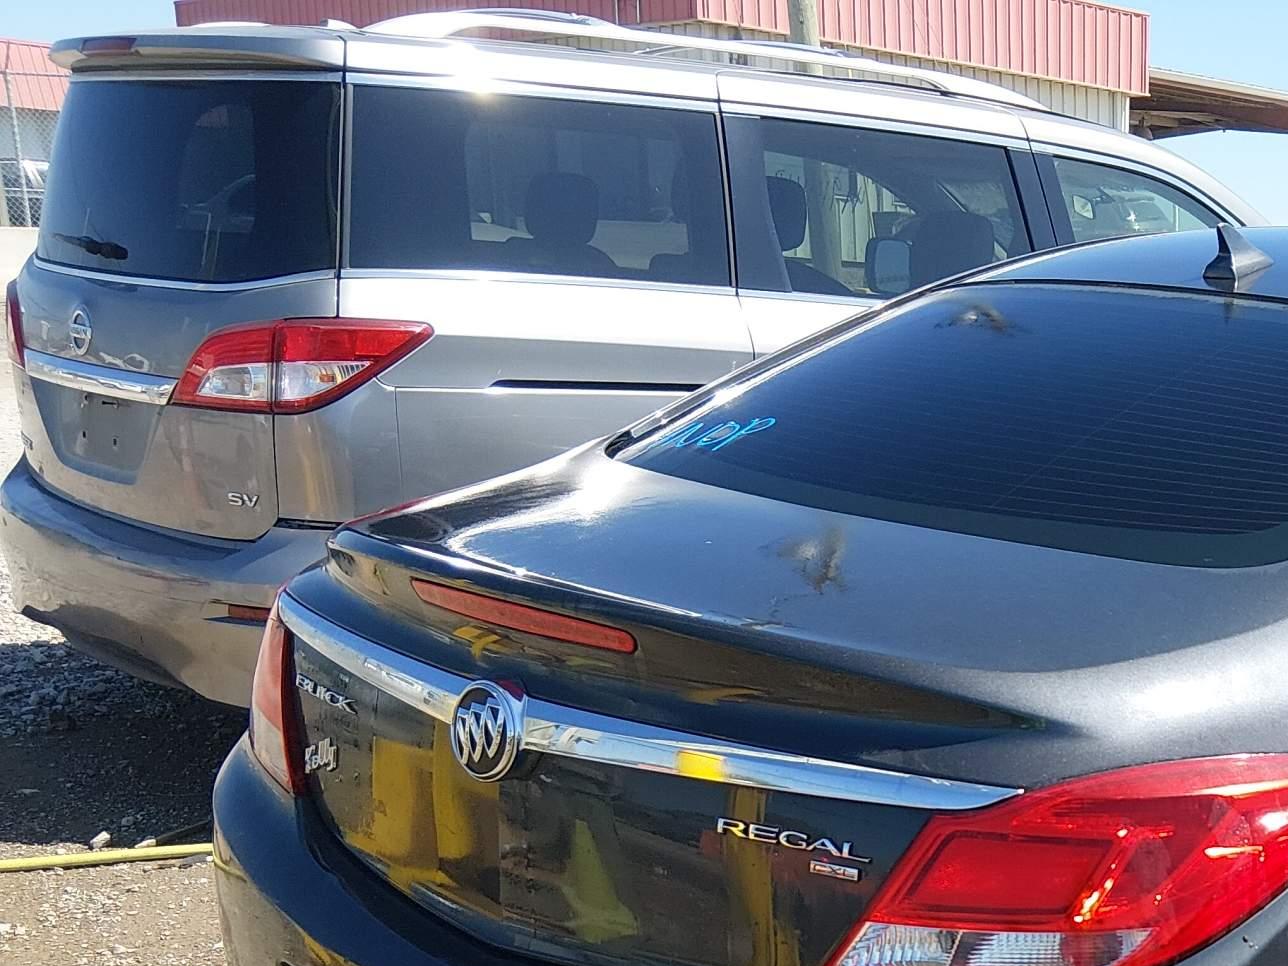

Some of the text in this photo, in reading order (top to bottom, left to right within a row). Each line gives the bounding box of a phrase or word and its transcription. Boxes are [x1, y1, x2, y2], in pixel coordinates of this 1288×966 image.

[228, 491, 259, 507] SV
[296, 672, 358, 715] BUICK
[716, 817, 872, 863] REGAL
[810, 861, 858, 881] CXL
